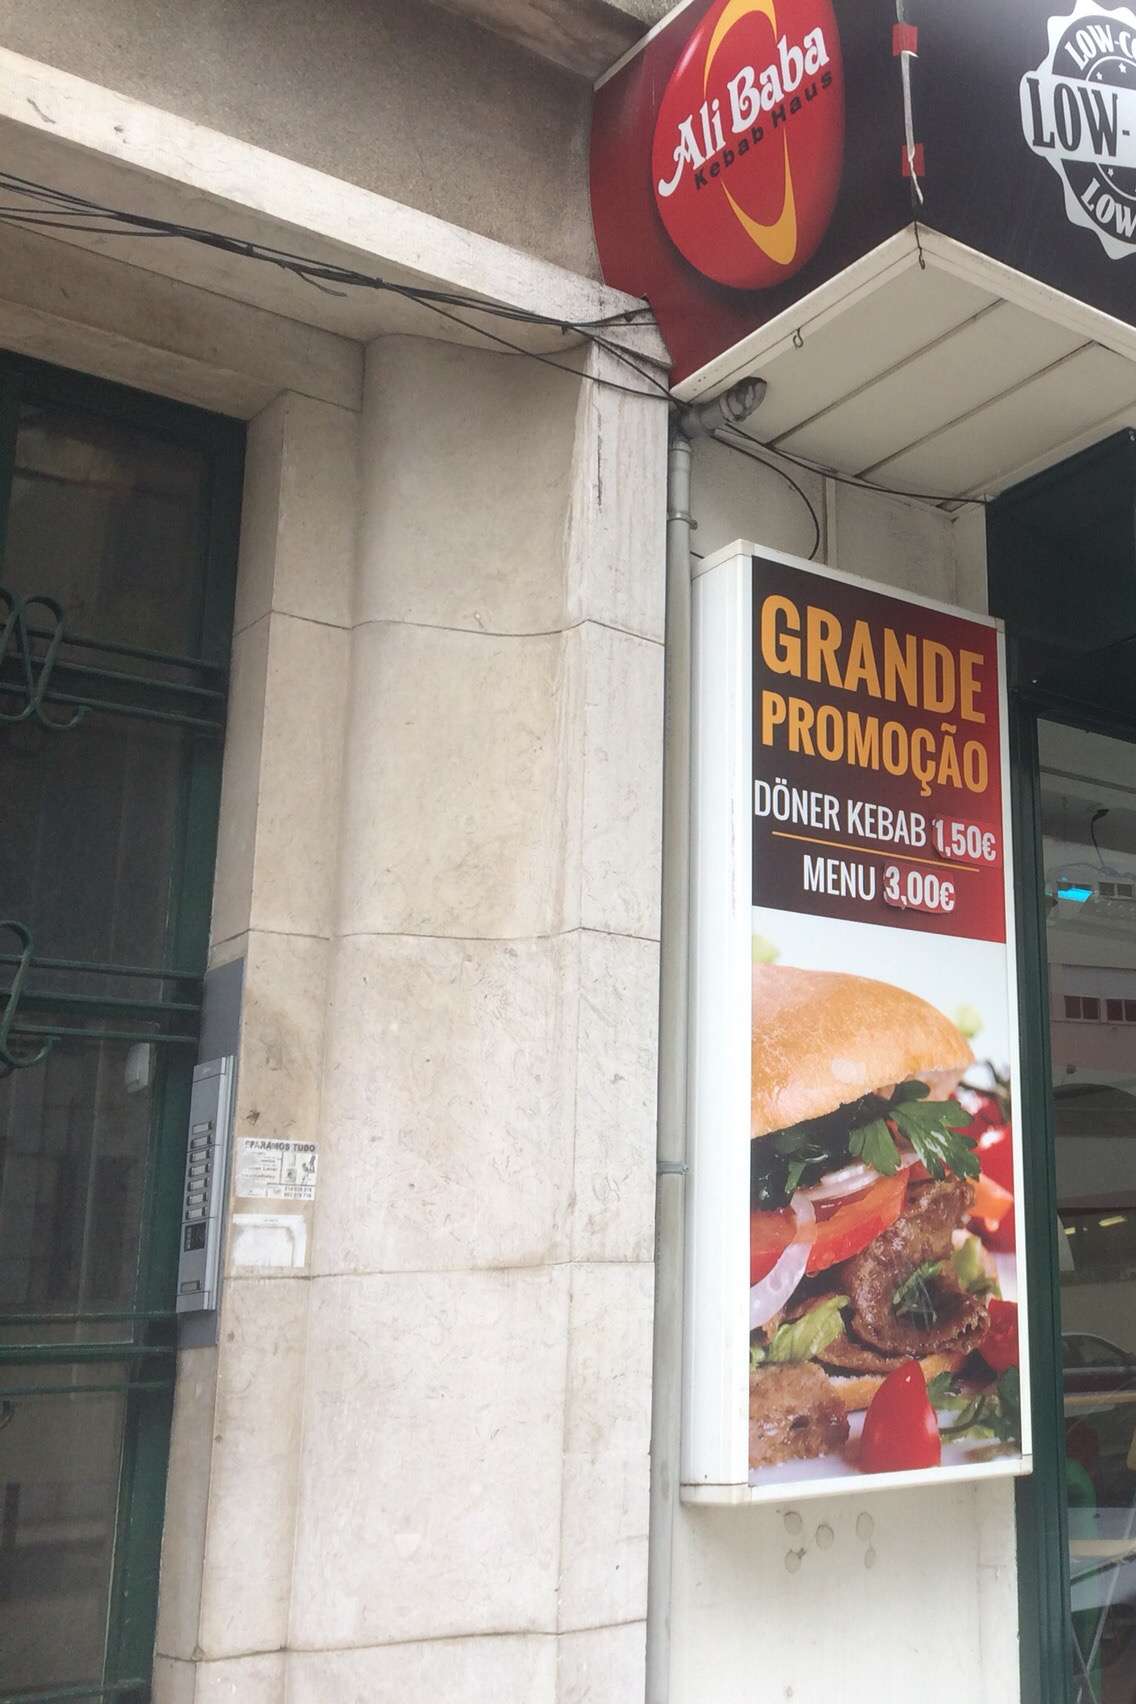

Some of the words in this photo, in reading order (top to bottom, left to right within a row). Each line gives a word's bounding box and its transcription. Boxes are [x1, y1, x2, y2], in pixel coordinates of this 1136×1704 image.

[658, 98, 726, 197] Ali
[727, 27, 830, 133] Baba
[694, 126, 764, 190] Kebab
[771, 71, 833, 128] Haus
[761, 594, 986, 724] GRANDE
[762, 688, 988, 797] PROMOÇÃO
[754, 777, 840, 832] DÖNER
[847, 799, 927, 848] KEBAB
[931, 818, 997, 861] 1,50€
[803, 854, 876, 901] MENU
[884, 865, 955, 911] 3,00€
